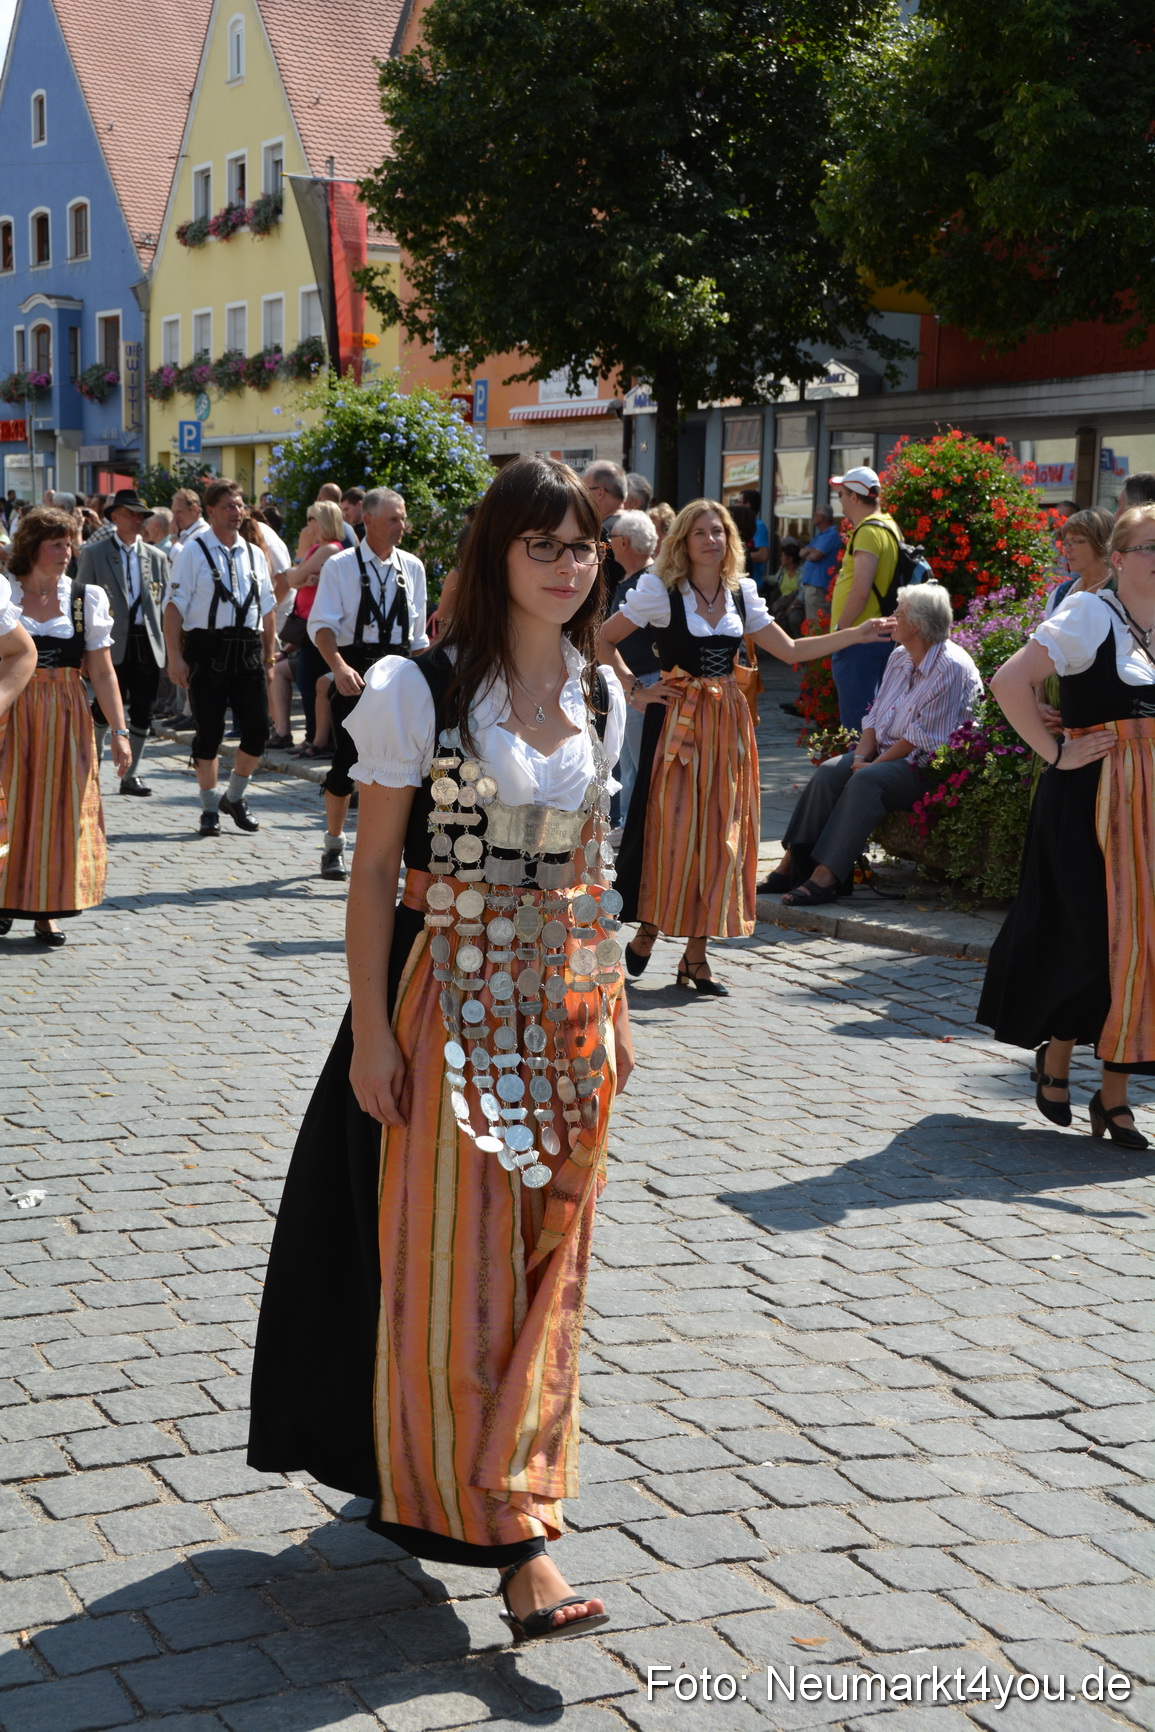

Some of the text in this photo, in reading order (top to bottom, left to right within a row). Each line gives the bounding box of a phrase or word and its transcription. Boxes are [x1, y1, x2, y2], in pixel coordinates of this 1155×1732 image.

[126, 360, 140, 425] WITTL
[476, 385, 485, 417] P
[183, 424, 197, 450] P
